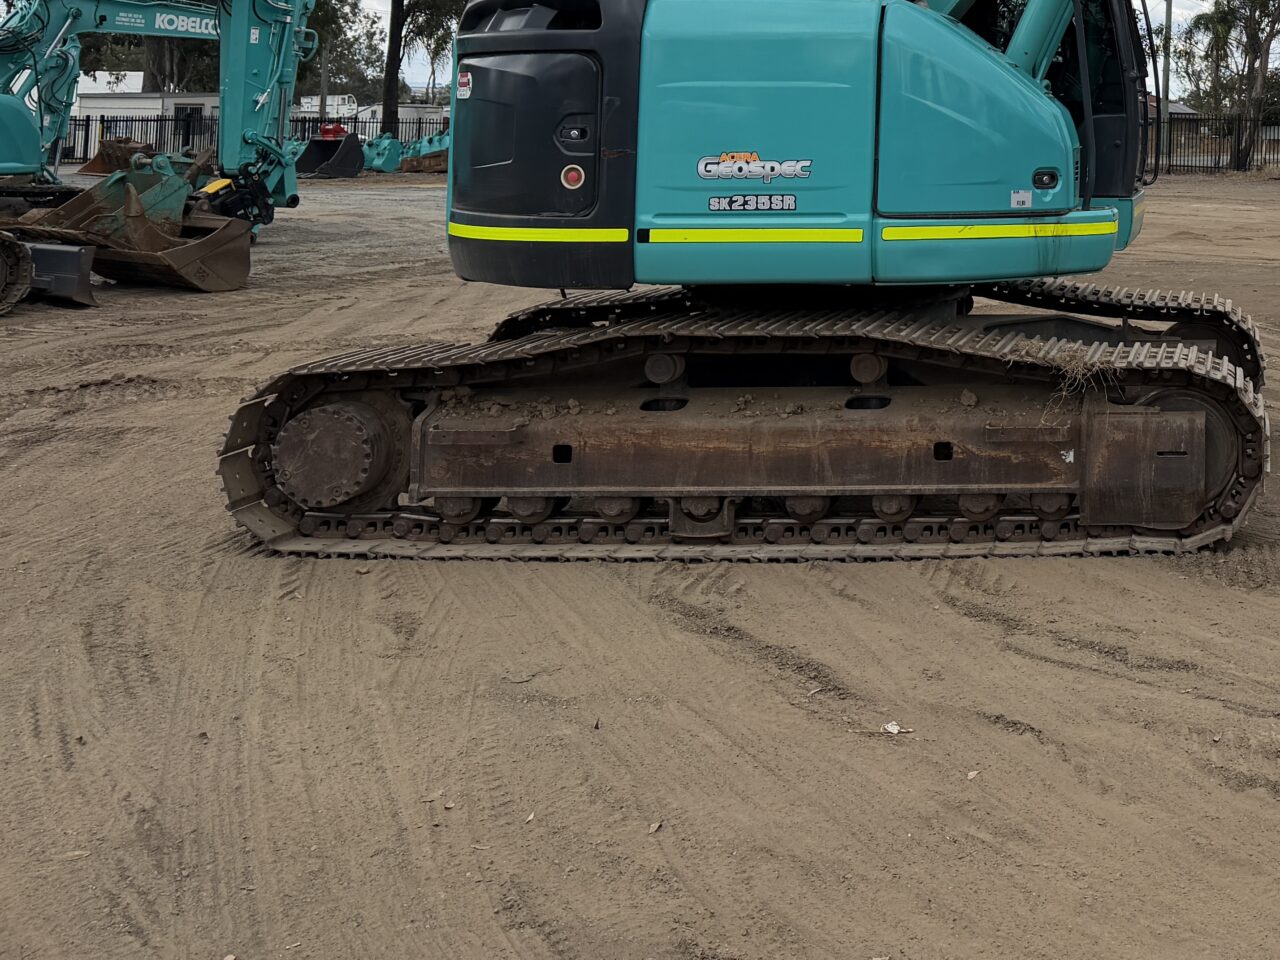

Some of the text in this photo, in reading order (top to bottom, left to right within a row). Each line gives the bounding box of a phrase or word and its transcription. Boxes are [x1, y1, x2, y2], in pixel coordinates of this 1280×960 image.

[155, 12, 221, 35] KOBELCO
[720, 152, 760, 161] ACERA
[709, 195, 796, 210] SK235SR
